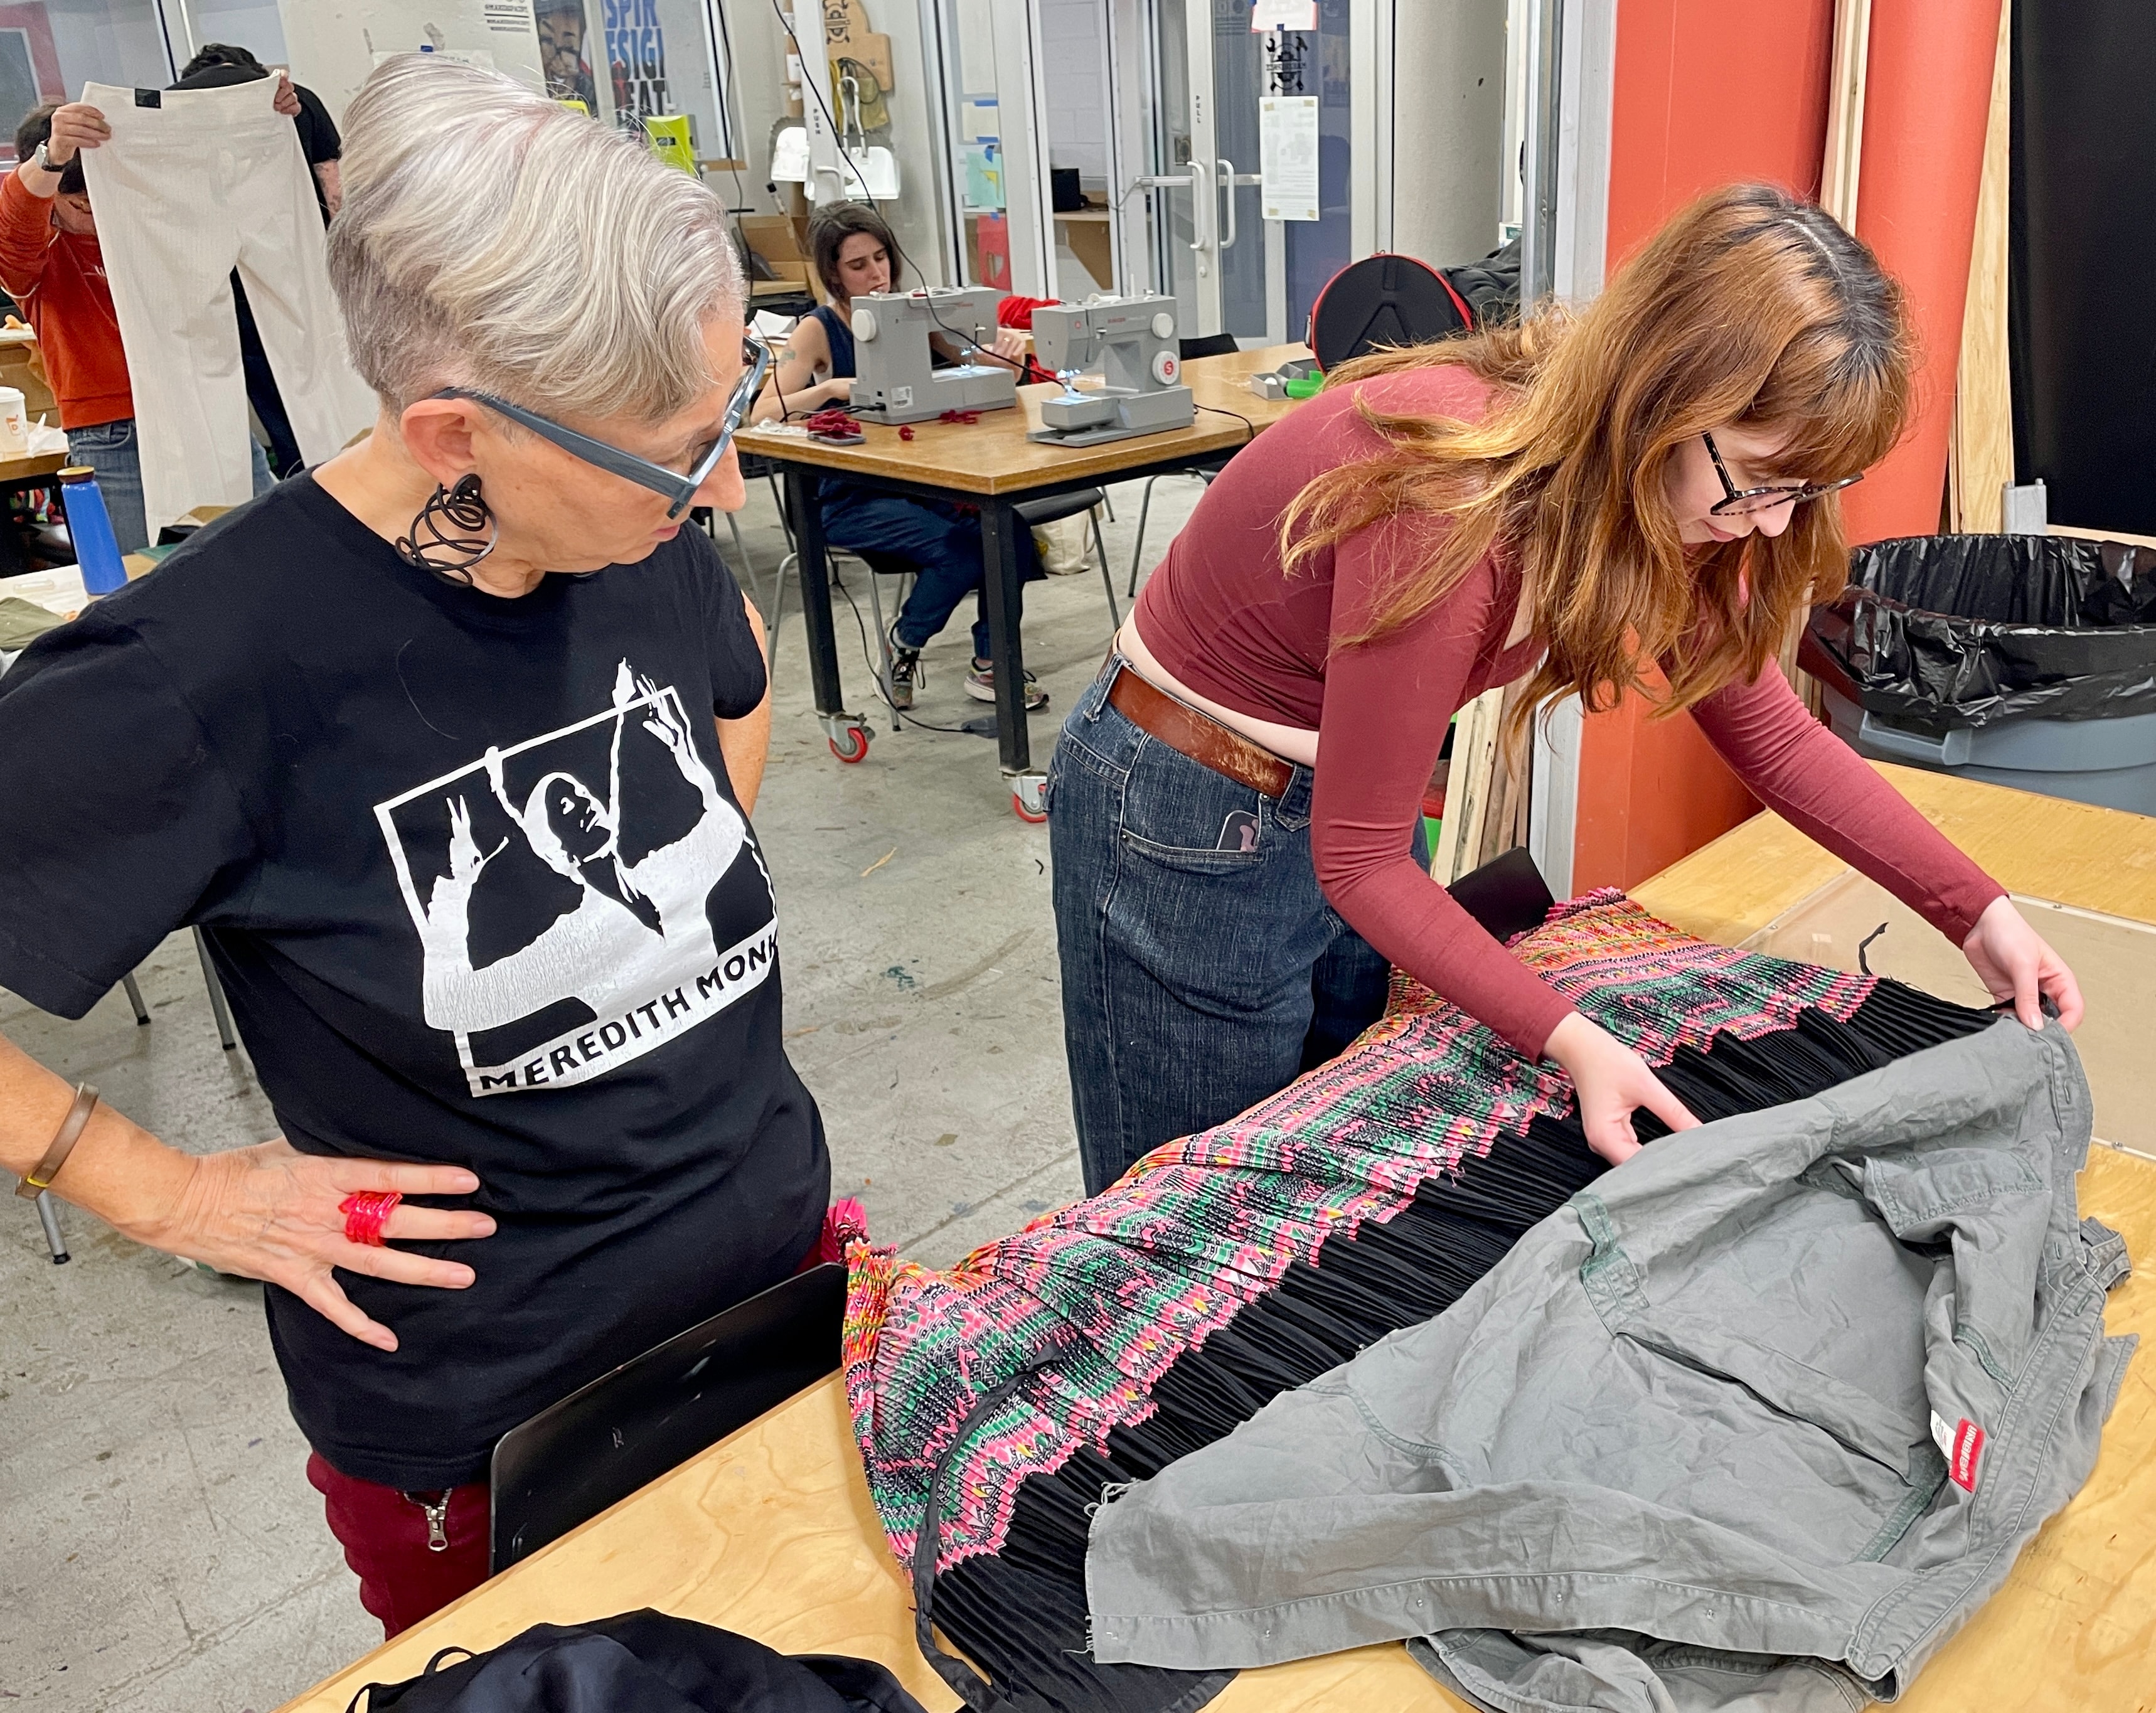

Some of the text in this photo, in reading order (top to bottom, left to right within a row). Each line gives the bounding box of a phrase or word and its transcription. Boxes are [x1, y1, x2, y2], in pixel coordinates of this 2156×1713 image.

[1165, 363, 1172, 375] S
[479, 932, 777, 1089] MEREDITH MONK
